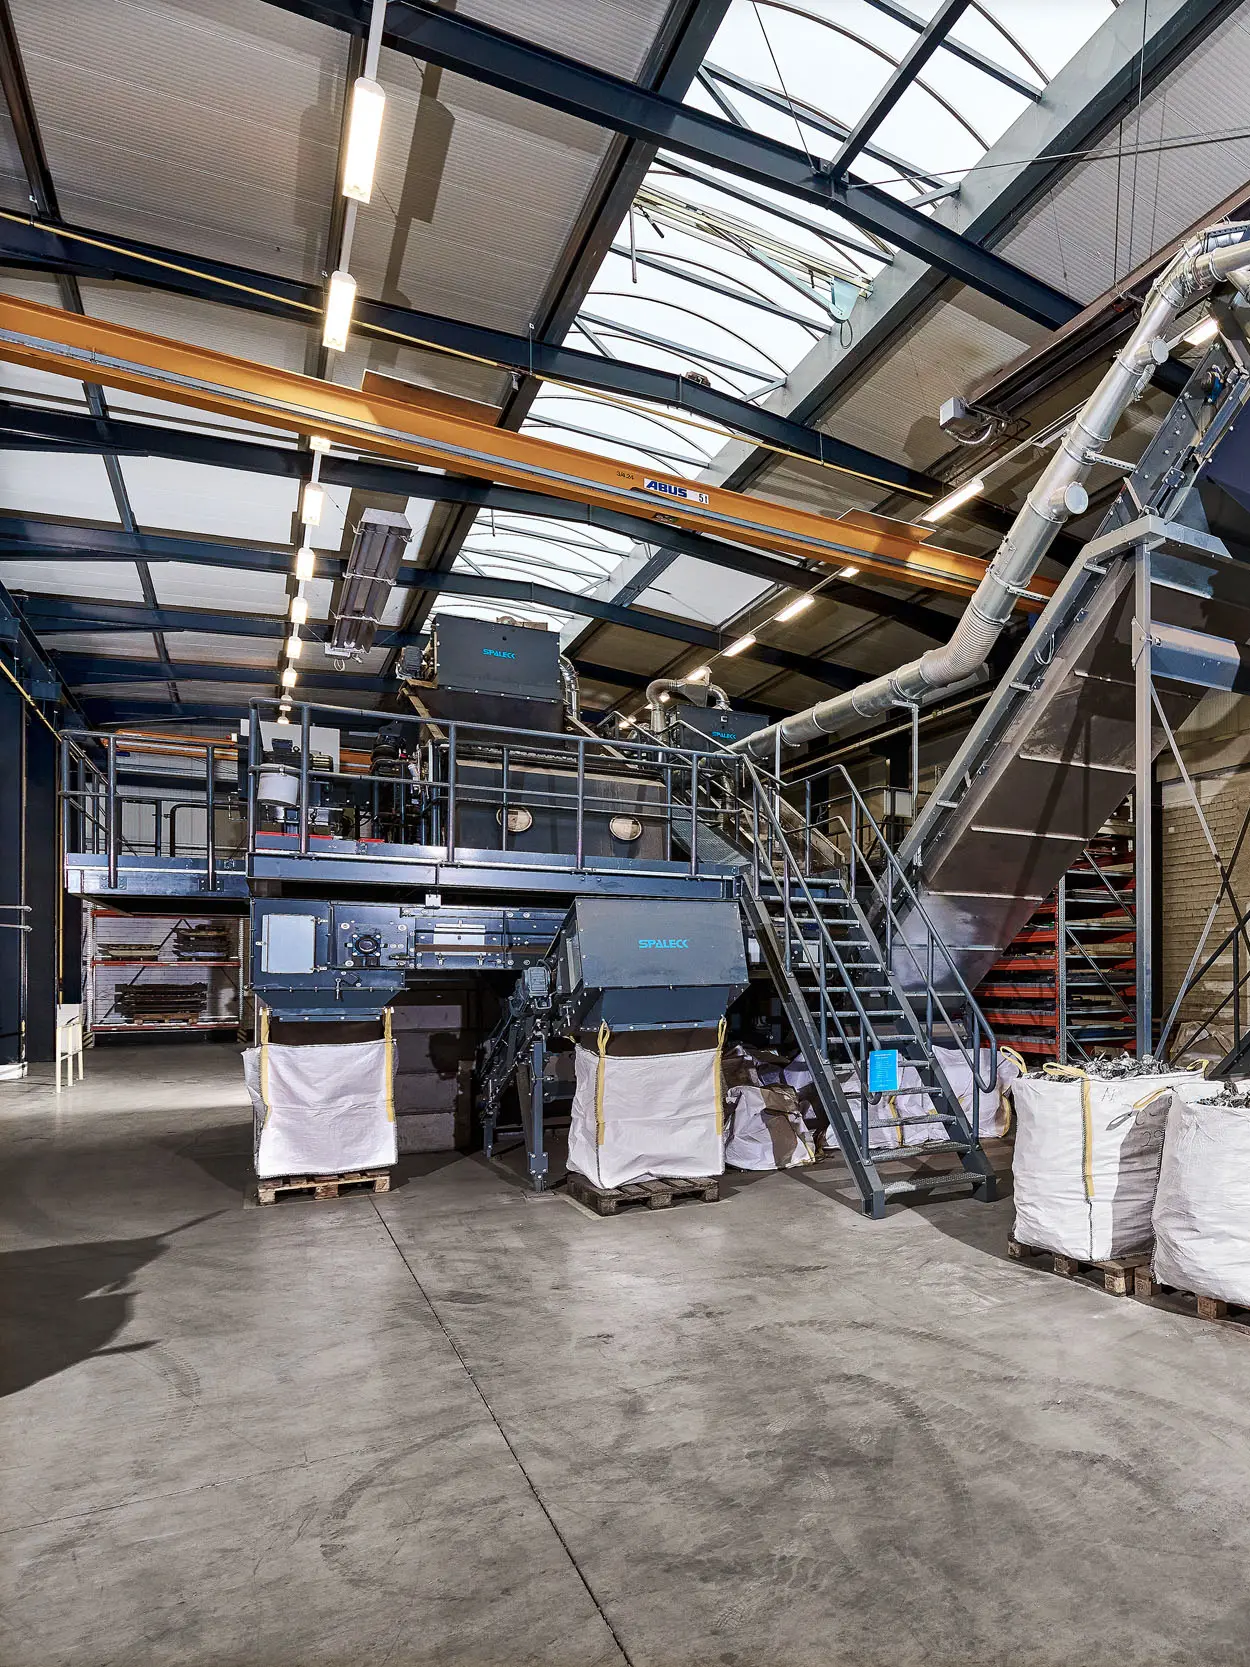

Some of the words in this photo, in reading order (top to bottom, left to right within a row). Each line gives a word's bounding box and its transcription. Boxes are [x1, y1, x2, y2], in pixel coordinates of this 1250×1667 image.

[646, 480, 688, 498] ABUS
[482, 648, 516, 660] SPALECK
[638, 939, 689, 949] SPALECK
